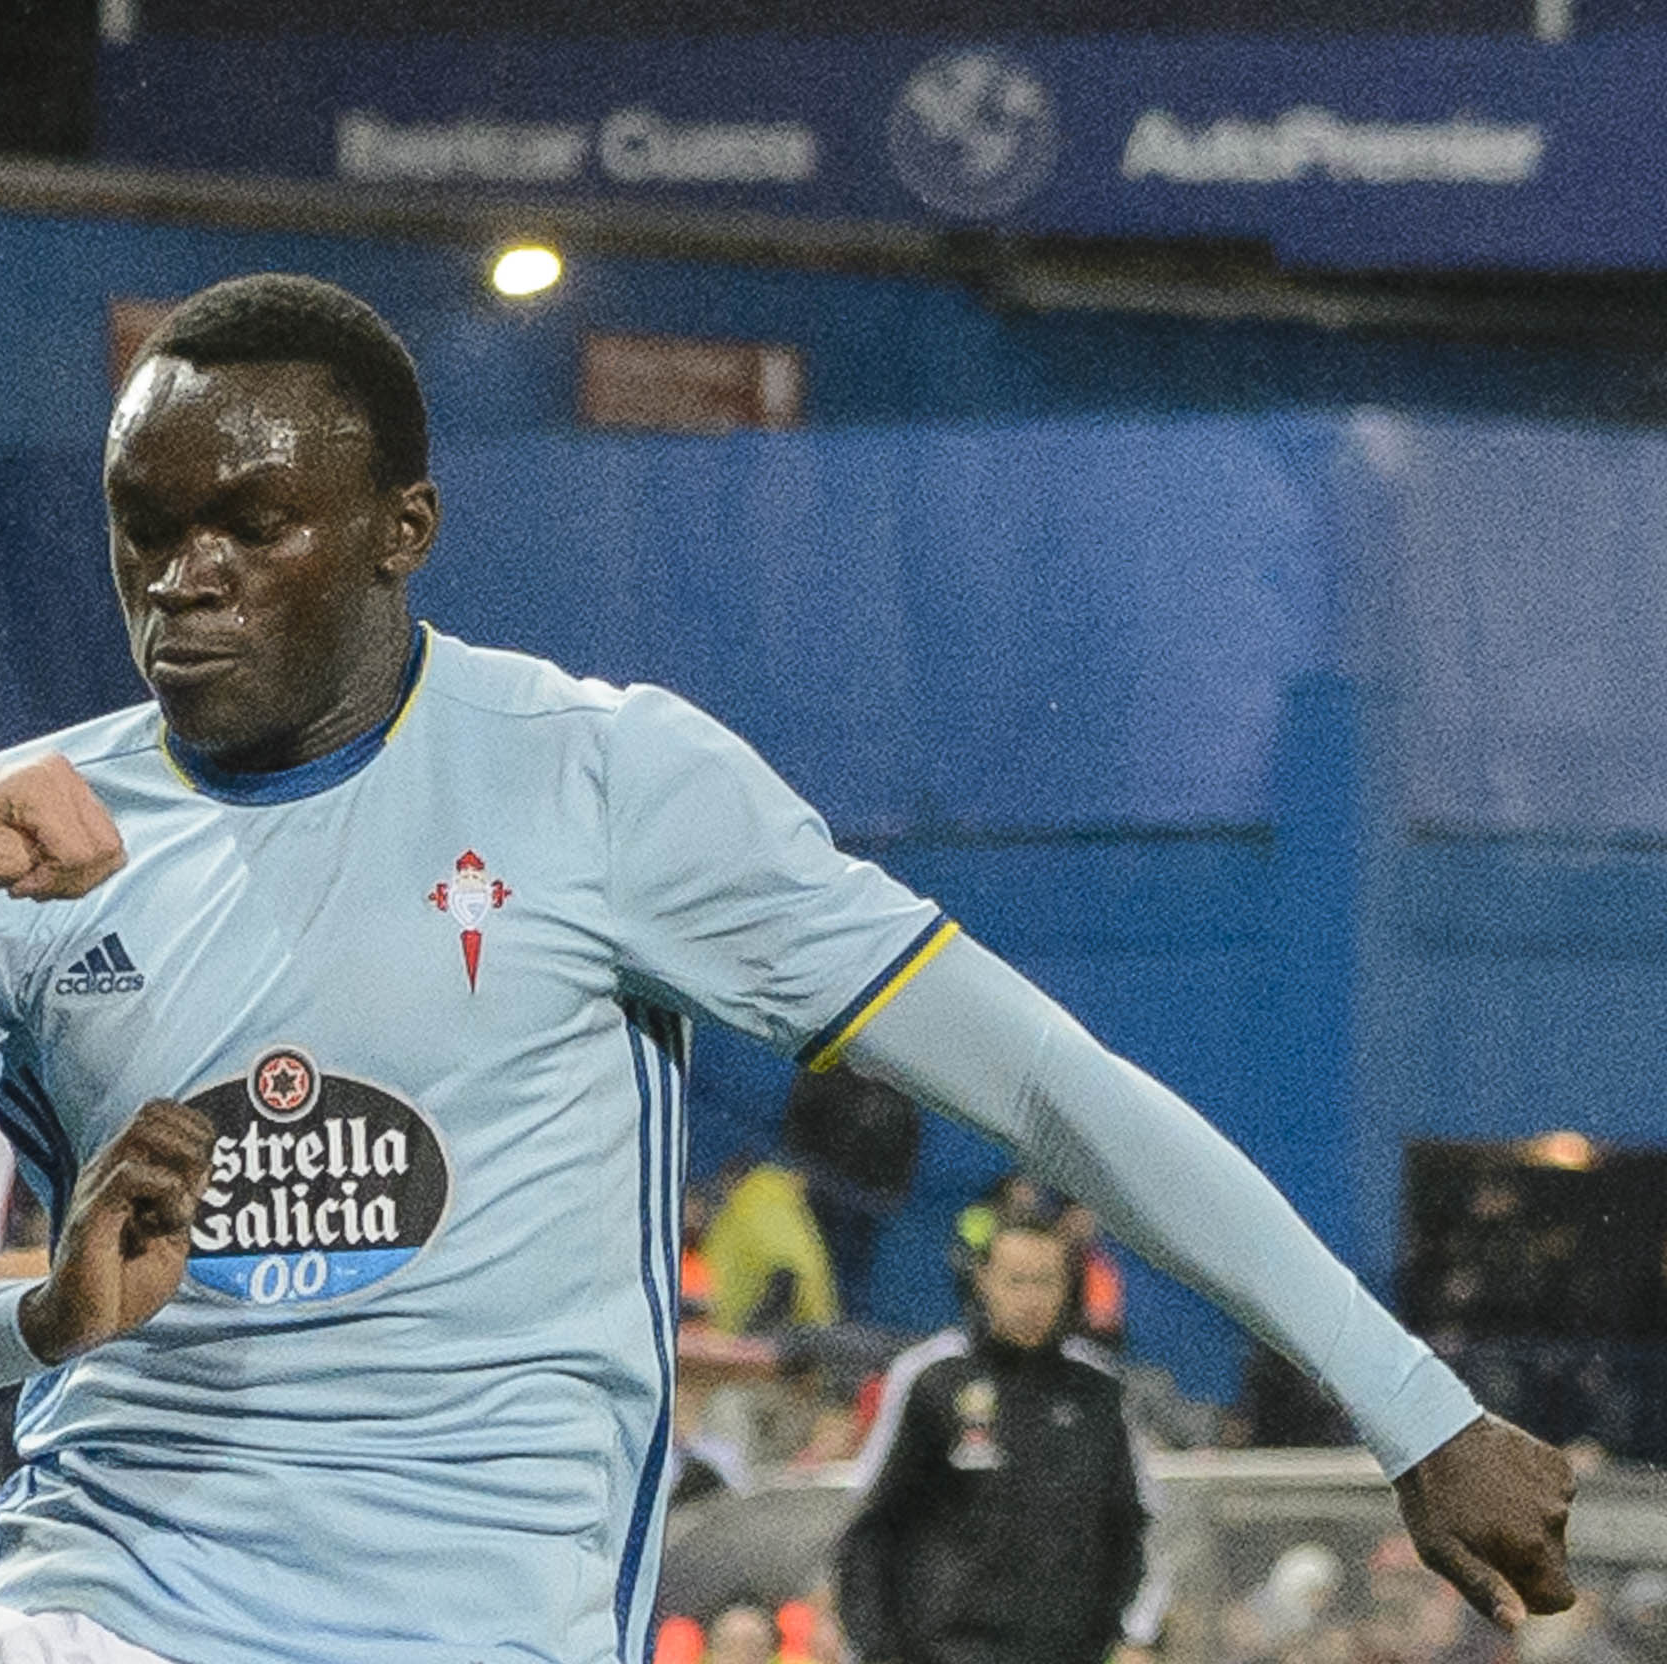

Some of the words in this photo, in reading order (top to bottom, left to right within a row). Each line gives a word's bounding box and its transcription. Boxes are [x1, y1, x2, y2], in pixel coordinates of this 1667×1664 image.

[55, 972, 145, 996] adidas
[211, 1116, 410, 1184] strella
[189, 1180, 400, 1250] Galicia
